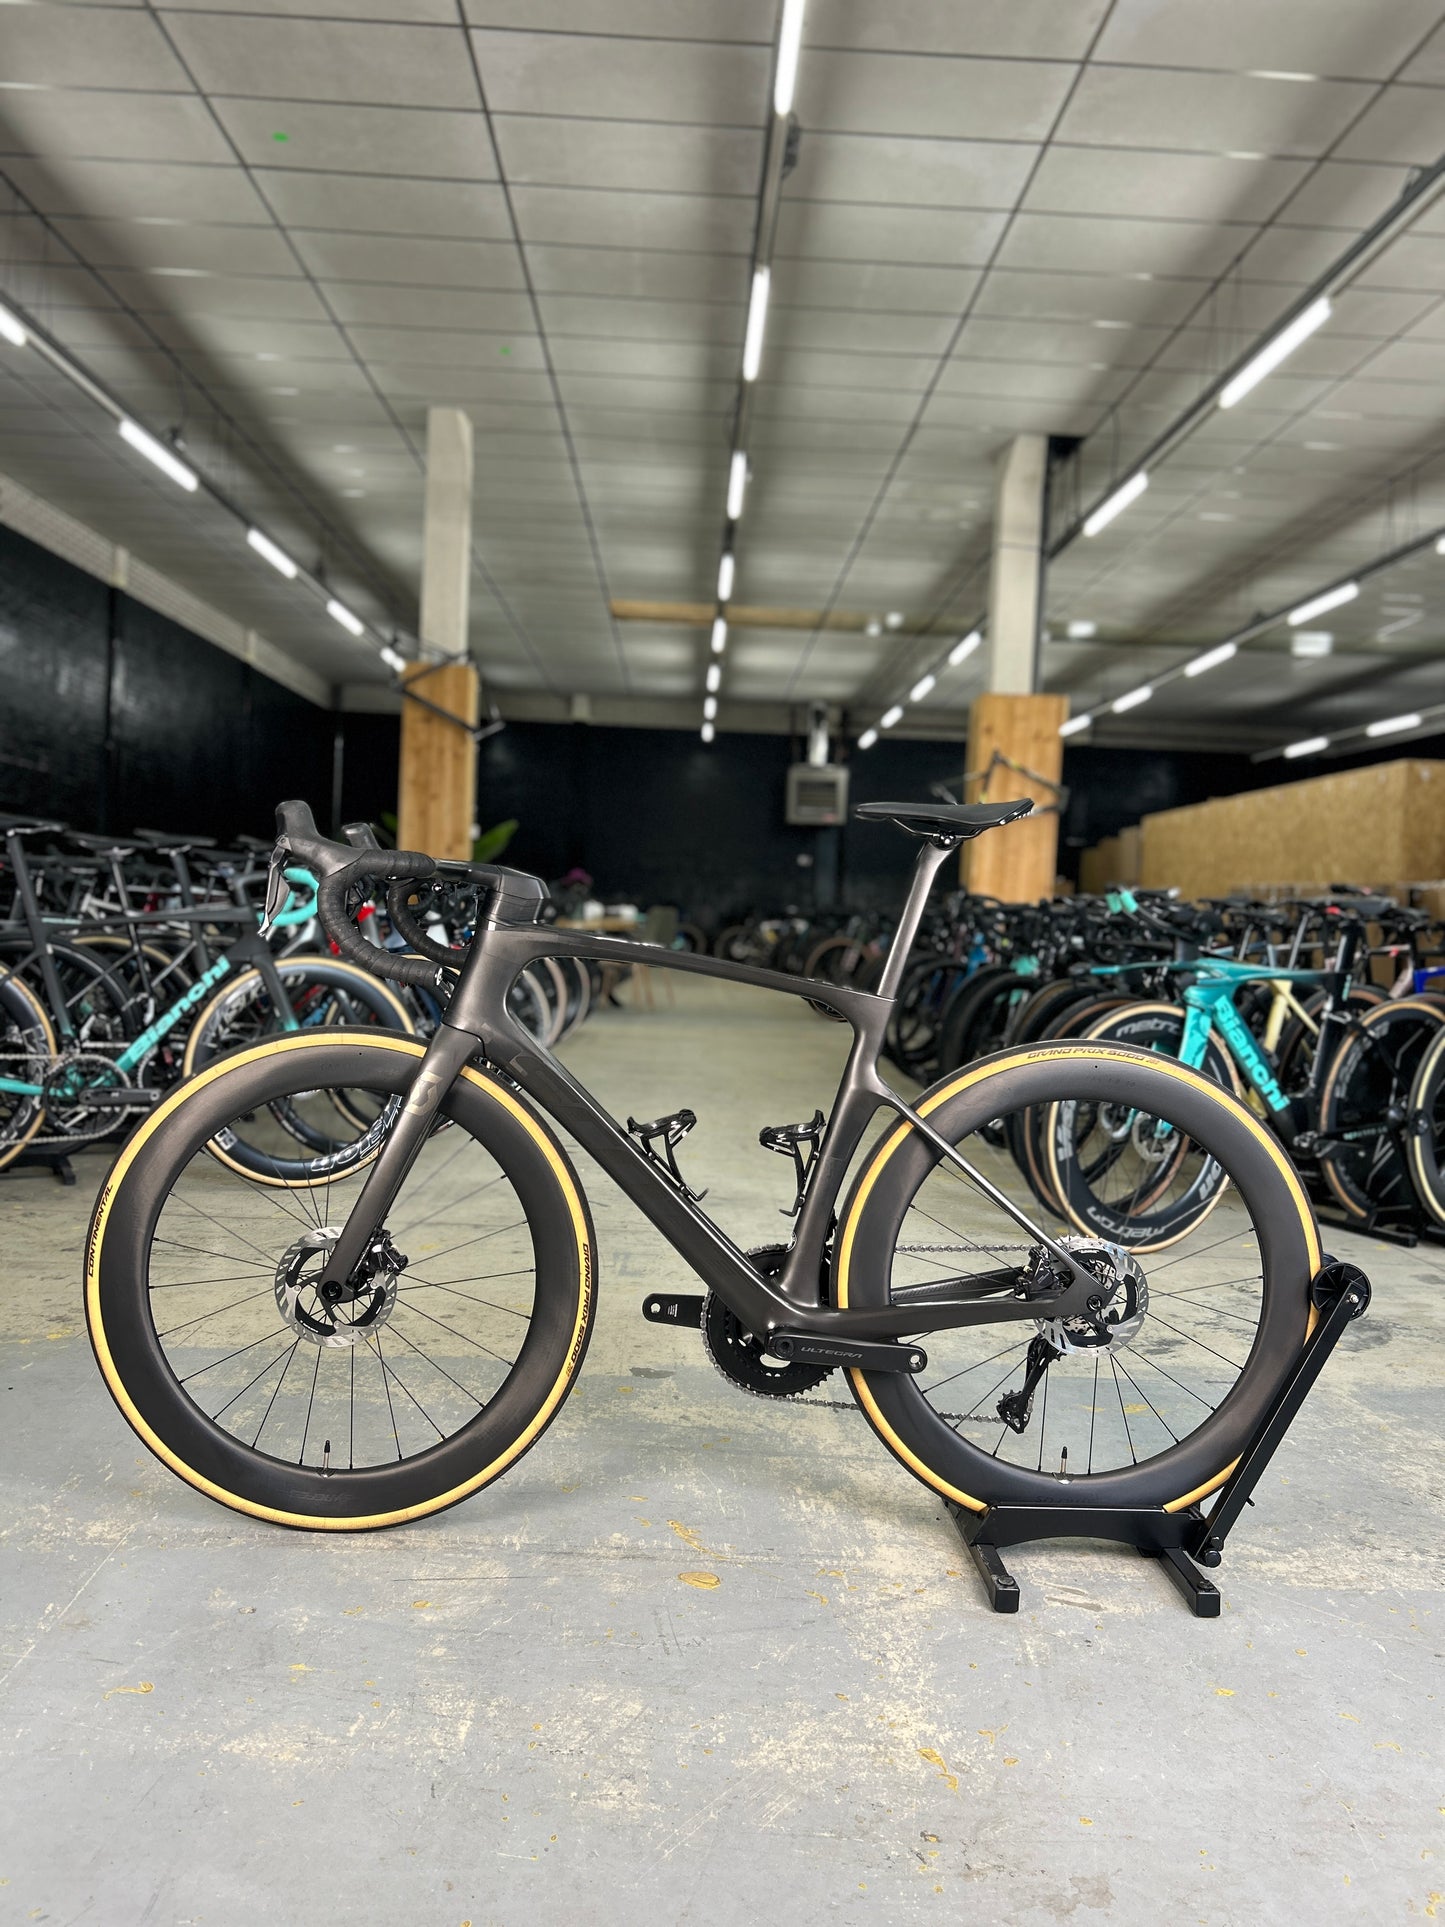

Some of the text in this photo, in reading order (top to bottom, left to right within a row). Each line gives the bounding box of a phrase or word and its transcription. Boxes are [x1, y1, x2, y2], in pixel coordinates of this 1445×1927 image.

[126, 954, 231, 1063] Bianchi
[1027, 1048, 1072, 1059] GRAND
[1073, 1047, 1104, 1055] PRIX
[1107, 1049, 1146, 1061] 5000
[1214, 995, 1291, 1112] Bianchi
[88, 1184, 114, 1278] CONTINENTAL
[1086, 1206, 1166, 1239] metron
[571, 1243, 591, 1364] GRAND PRIX 5000
[800, 1346, 863, 1359] ULTEGRA
